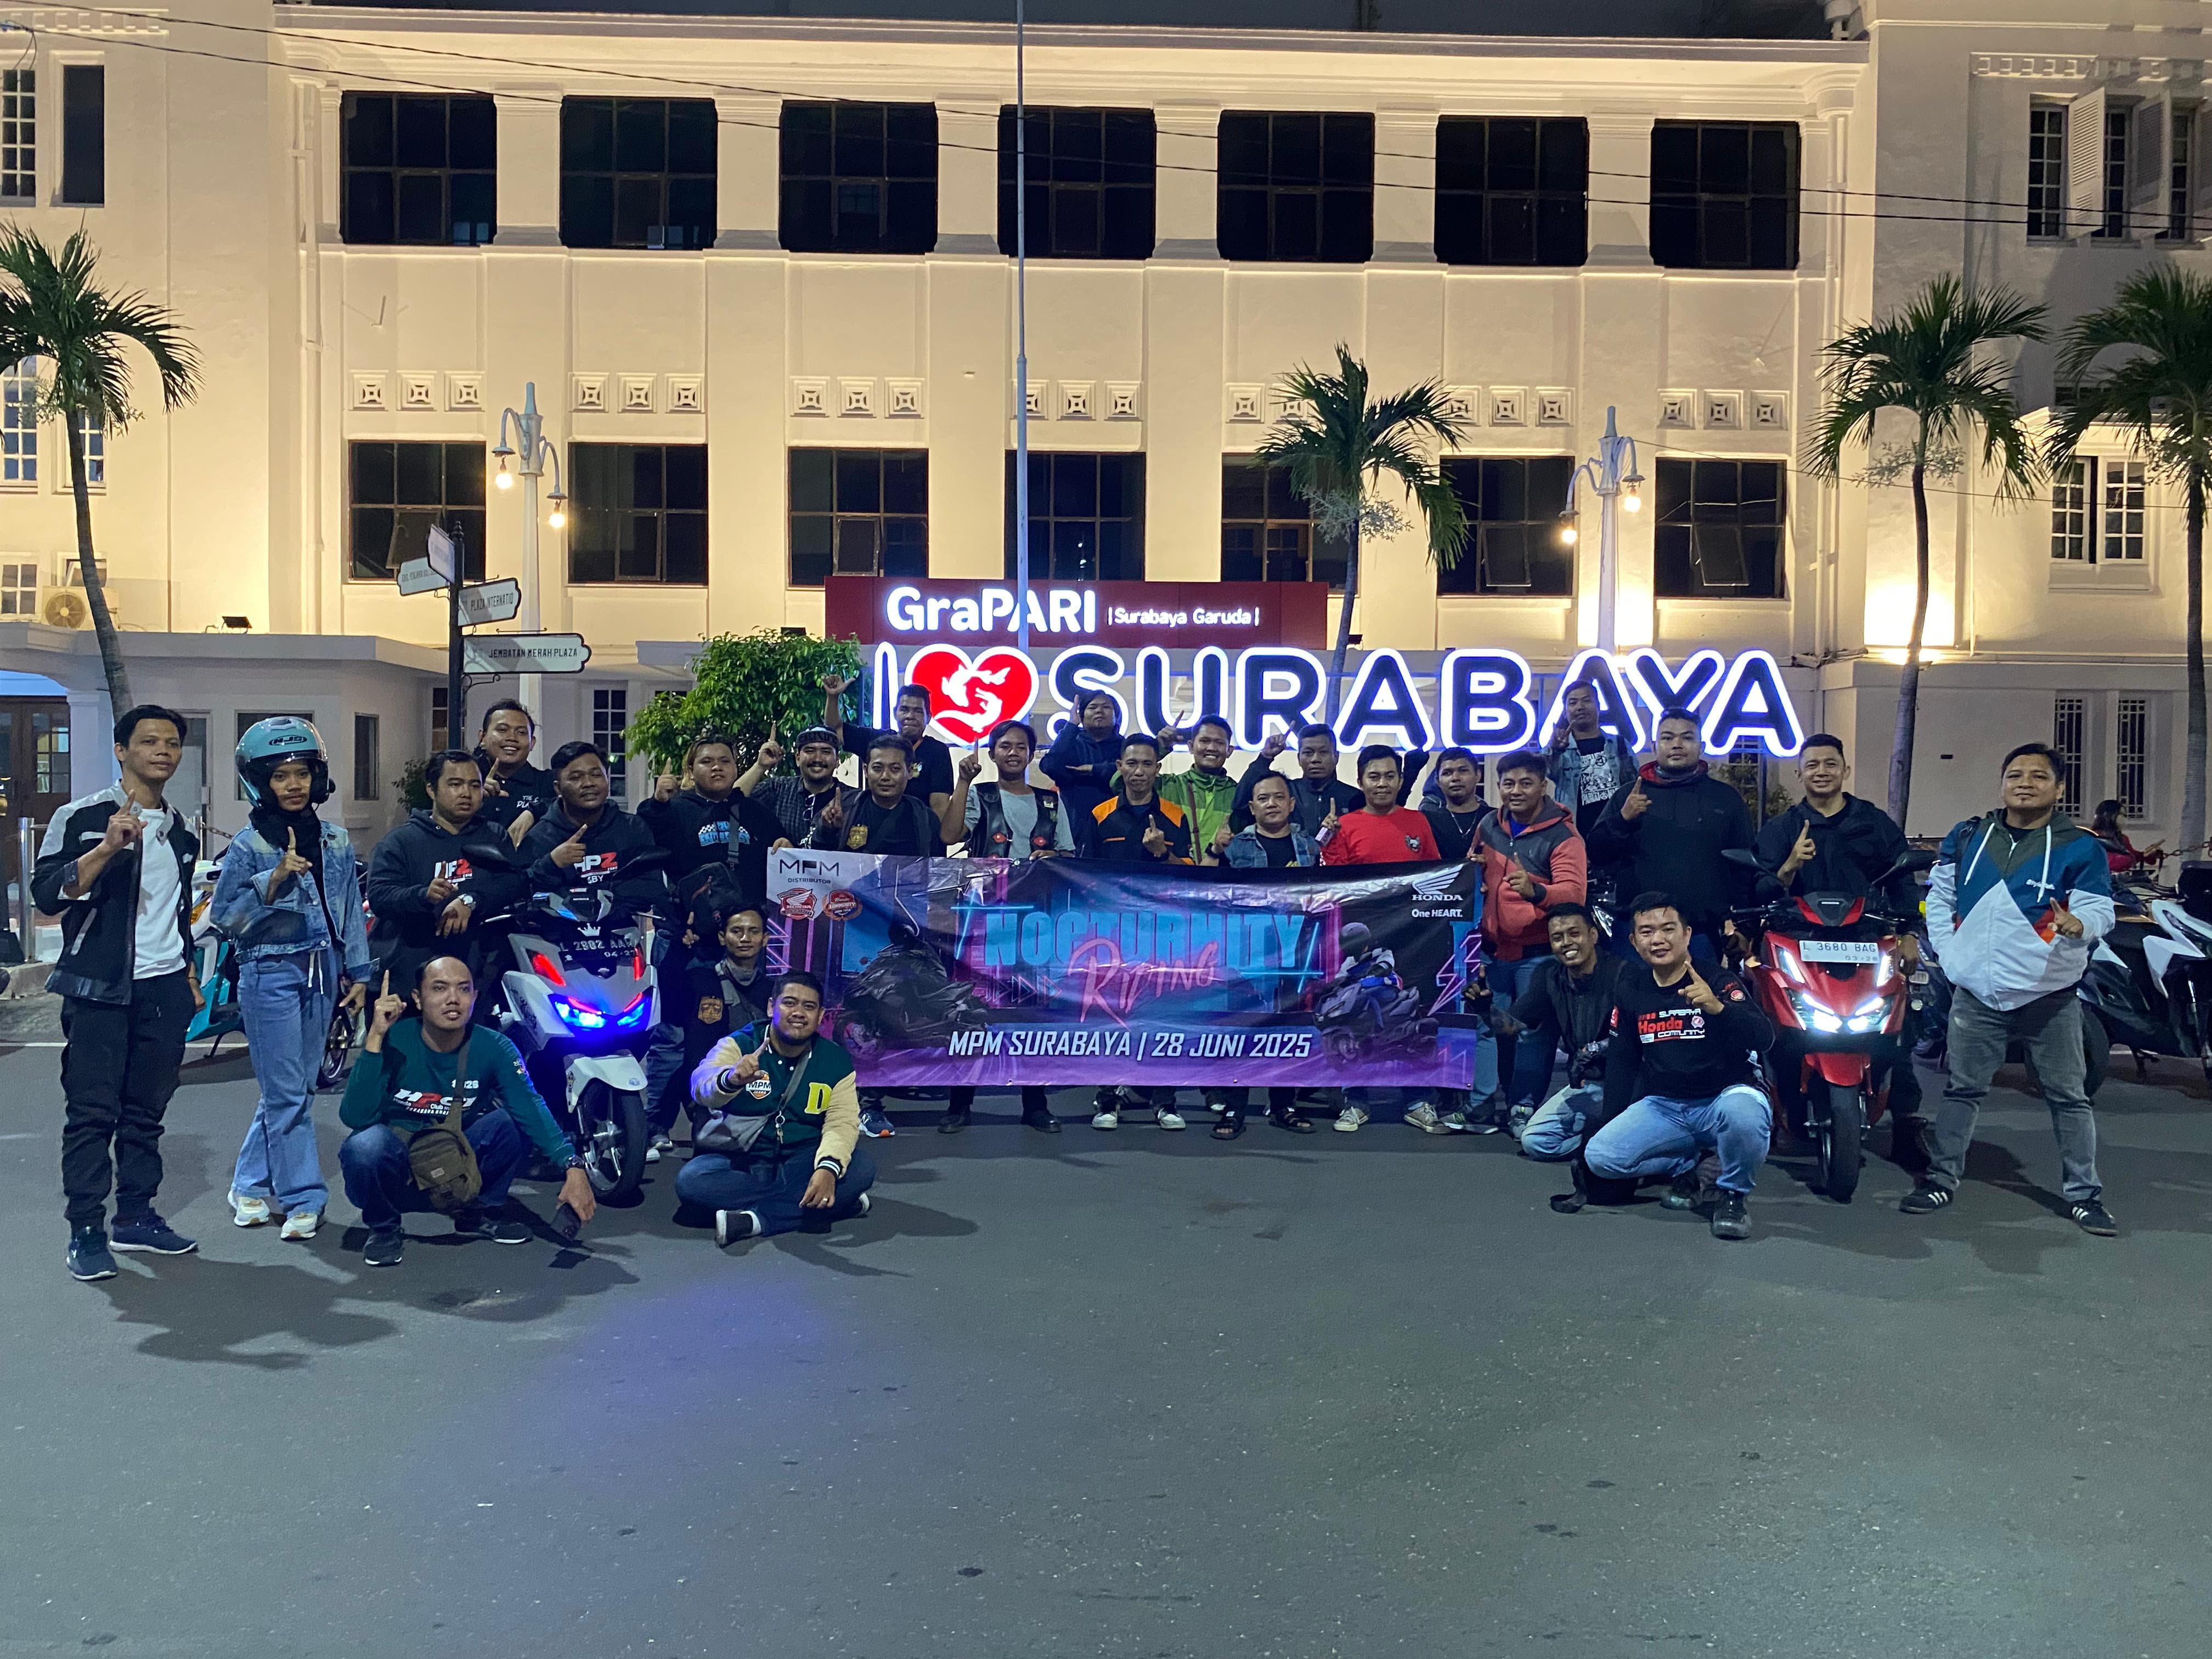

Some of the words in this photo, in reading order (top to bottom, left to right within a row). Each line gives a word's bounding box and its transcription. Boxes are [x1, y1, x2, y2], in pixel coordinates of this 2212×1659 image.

[470, 599, 486, 611] PLAZA
[887, 586, 1096, 633] GraPARI
[488, 648, 526, 658] JEMBATAN
[527, 648, 552, 658] MERAH
[554, 648, 577, 658] PLAZA
[1047, 645, 1805, 758] SURABAYA
[779, 859, 839, 877] MPM
[587, 874, 603, 884] SBY
[1411, 909, 1430, 918] One
[985, 911, 1305, 968] NOCTURNITY
[1803, 941, 1810, 951] L
[1816, 942, 1848, 951] 3680
[1854, 943, 1876, 952] BAG
[1638, 1017, 1683, 1035] Honda
[948, 1031, 1005, 1056] MPM
[1008, 1031, 1132, 1056] SURABAYA
[1151, 1032, 1185, 1057] 28
[1188, 1034, 1246, 1058] JUNI
[1249, 1034, 1313, 1058] 2025
[748, 1081, 771, 1090] MPM
[804, 1082, 833, 1115] D
